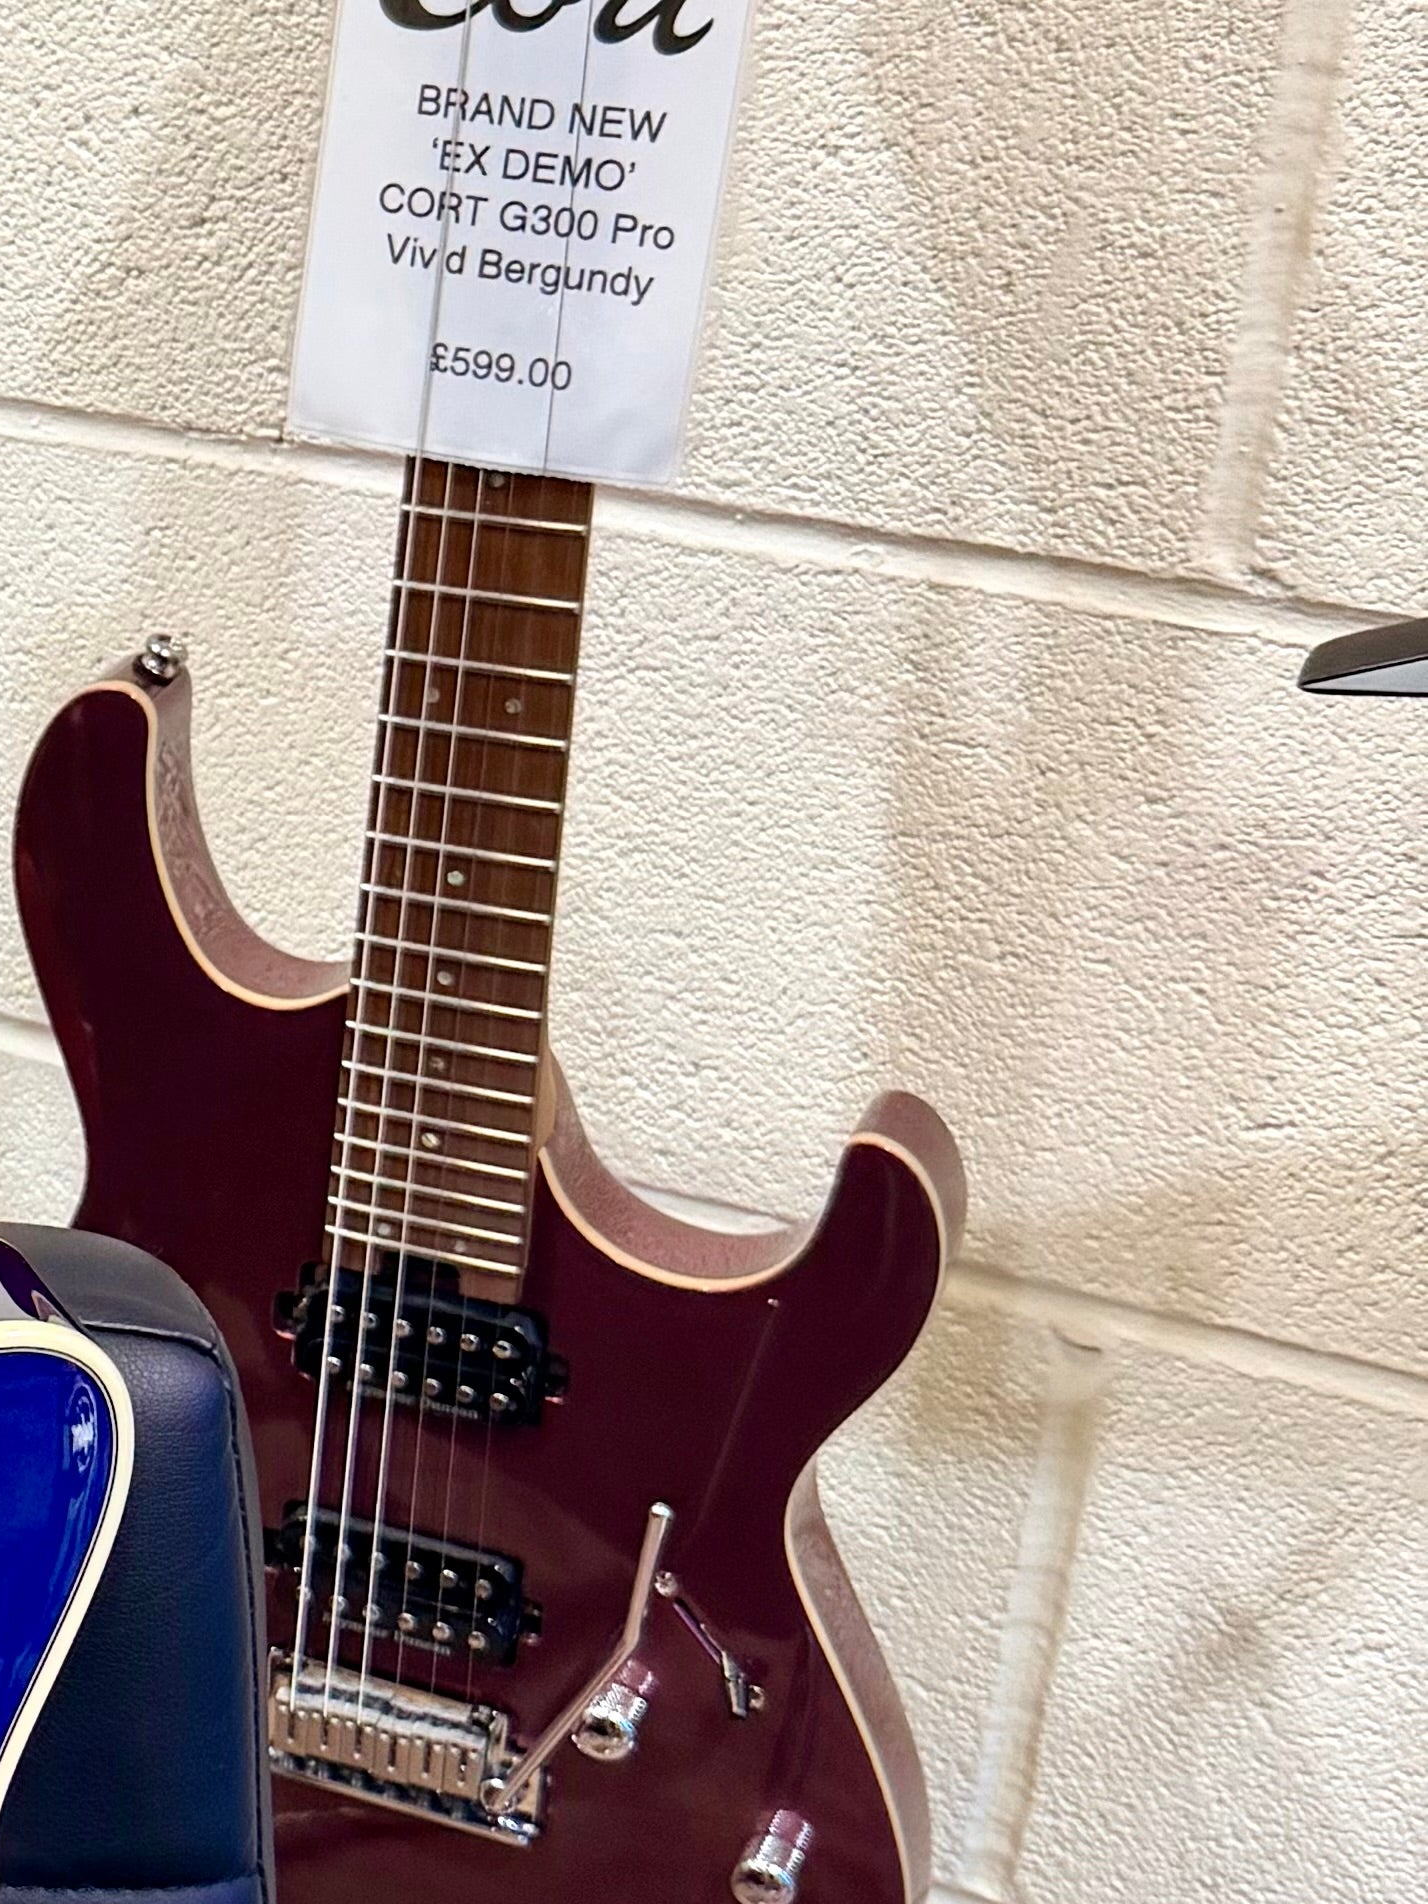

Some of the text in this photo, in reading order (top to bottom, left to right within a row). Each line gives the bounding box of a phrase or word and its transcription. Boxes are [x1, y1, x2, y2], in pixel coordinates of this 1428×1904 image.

[416, 83, 667, 144] BRAND NEW
[378, 182, 676, 251] CORT G300 Pro
[385, 234, 655, 307] Vivd Bergundy
[429, 342, 573, 392] £599.00
